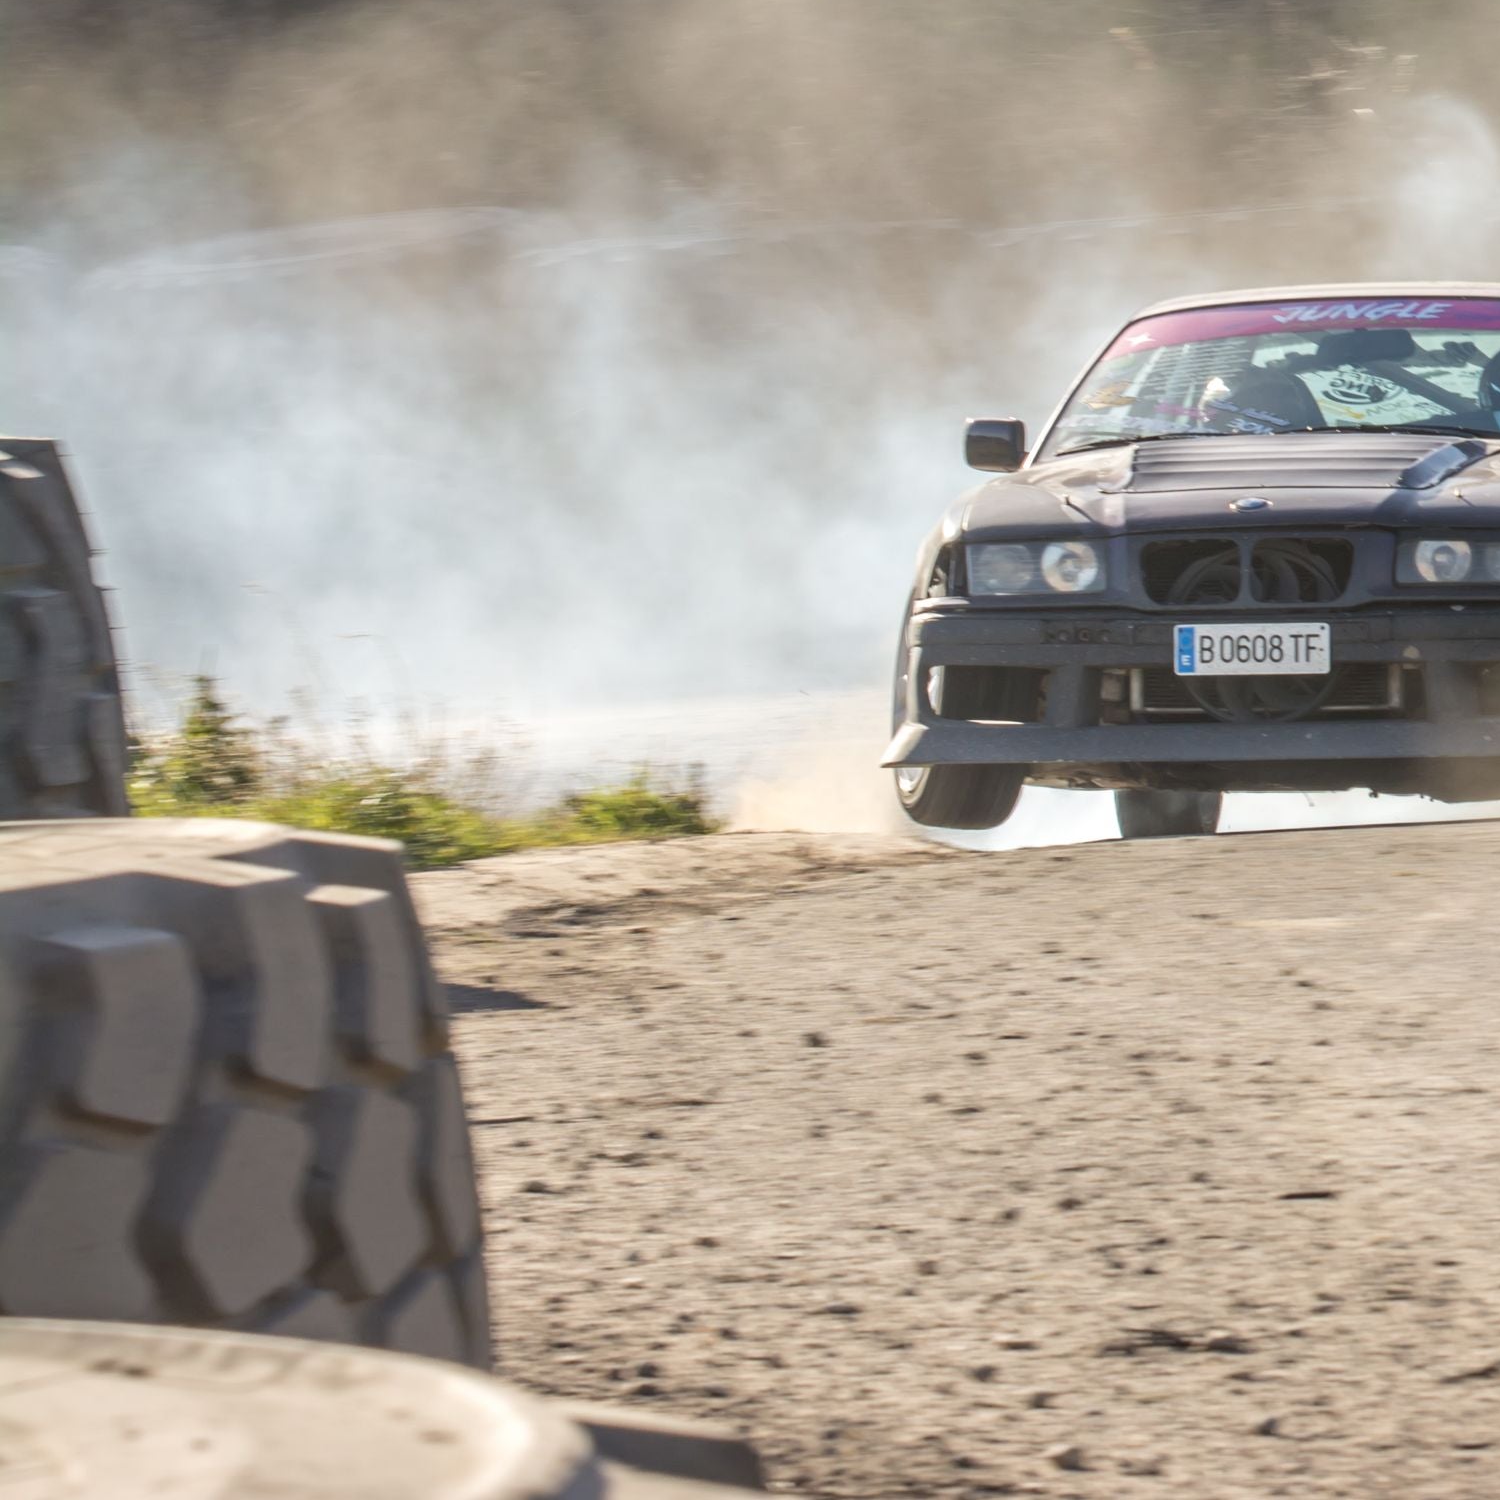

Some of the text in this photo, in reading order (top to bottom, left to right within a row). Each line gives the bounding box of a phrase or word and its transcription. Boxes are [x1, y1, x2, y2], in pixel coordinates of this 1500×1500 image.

[1272, 301, 1454, 324] JUNGLE
[1200, 633, 1321, 664] B 0608 TF
[1180, 654, 1192, 667] E
